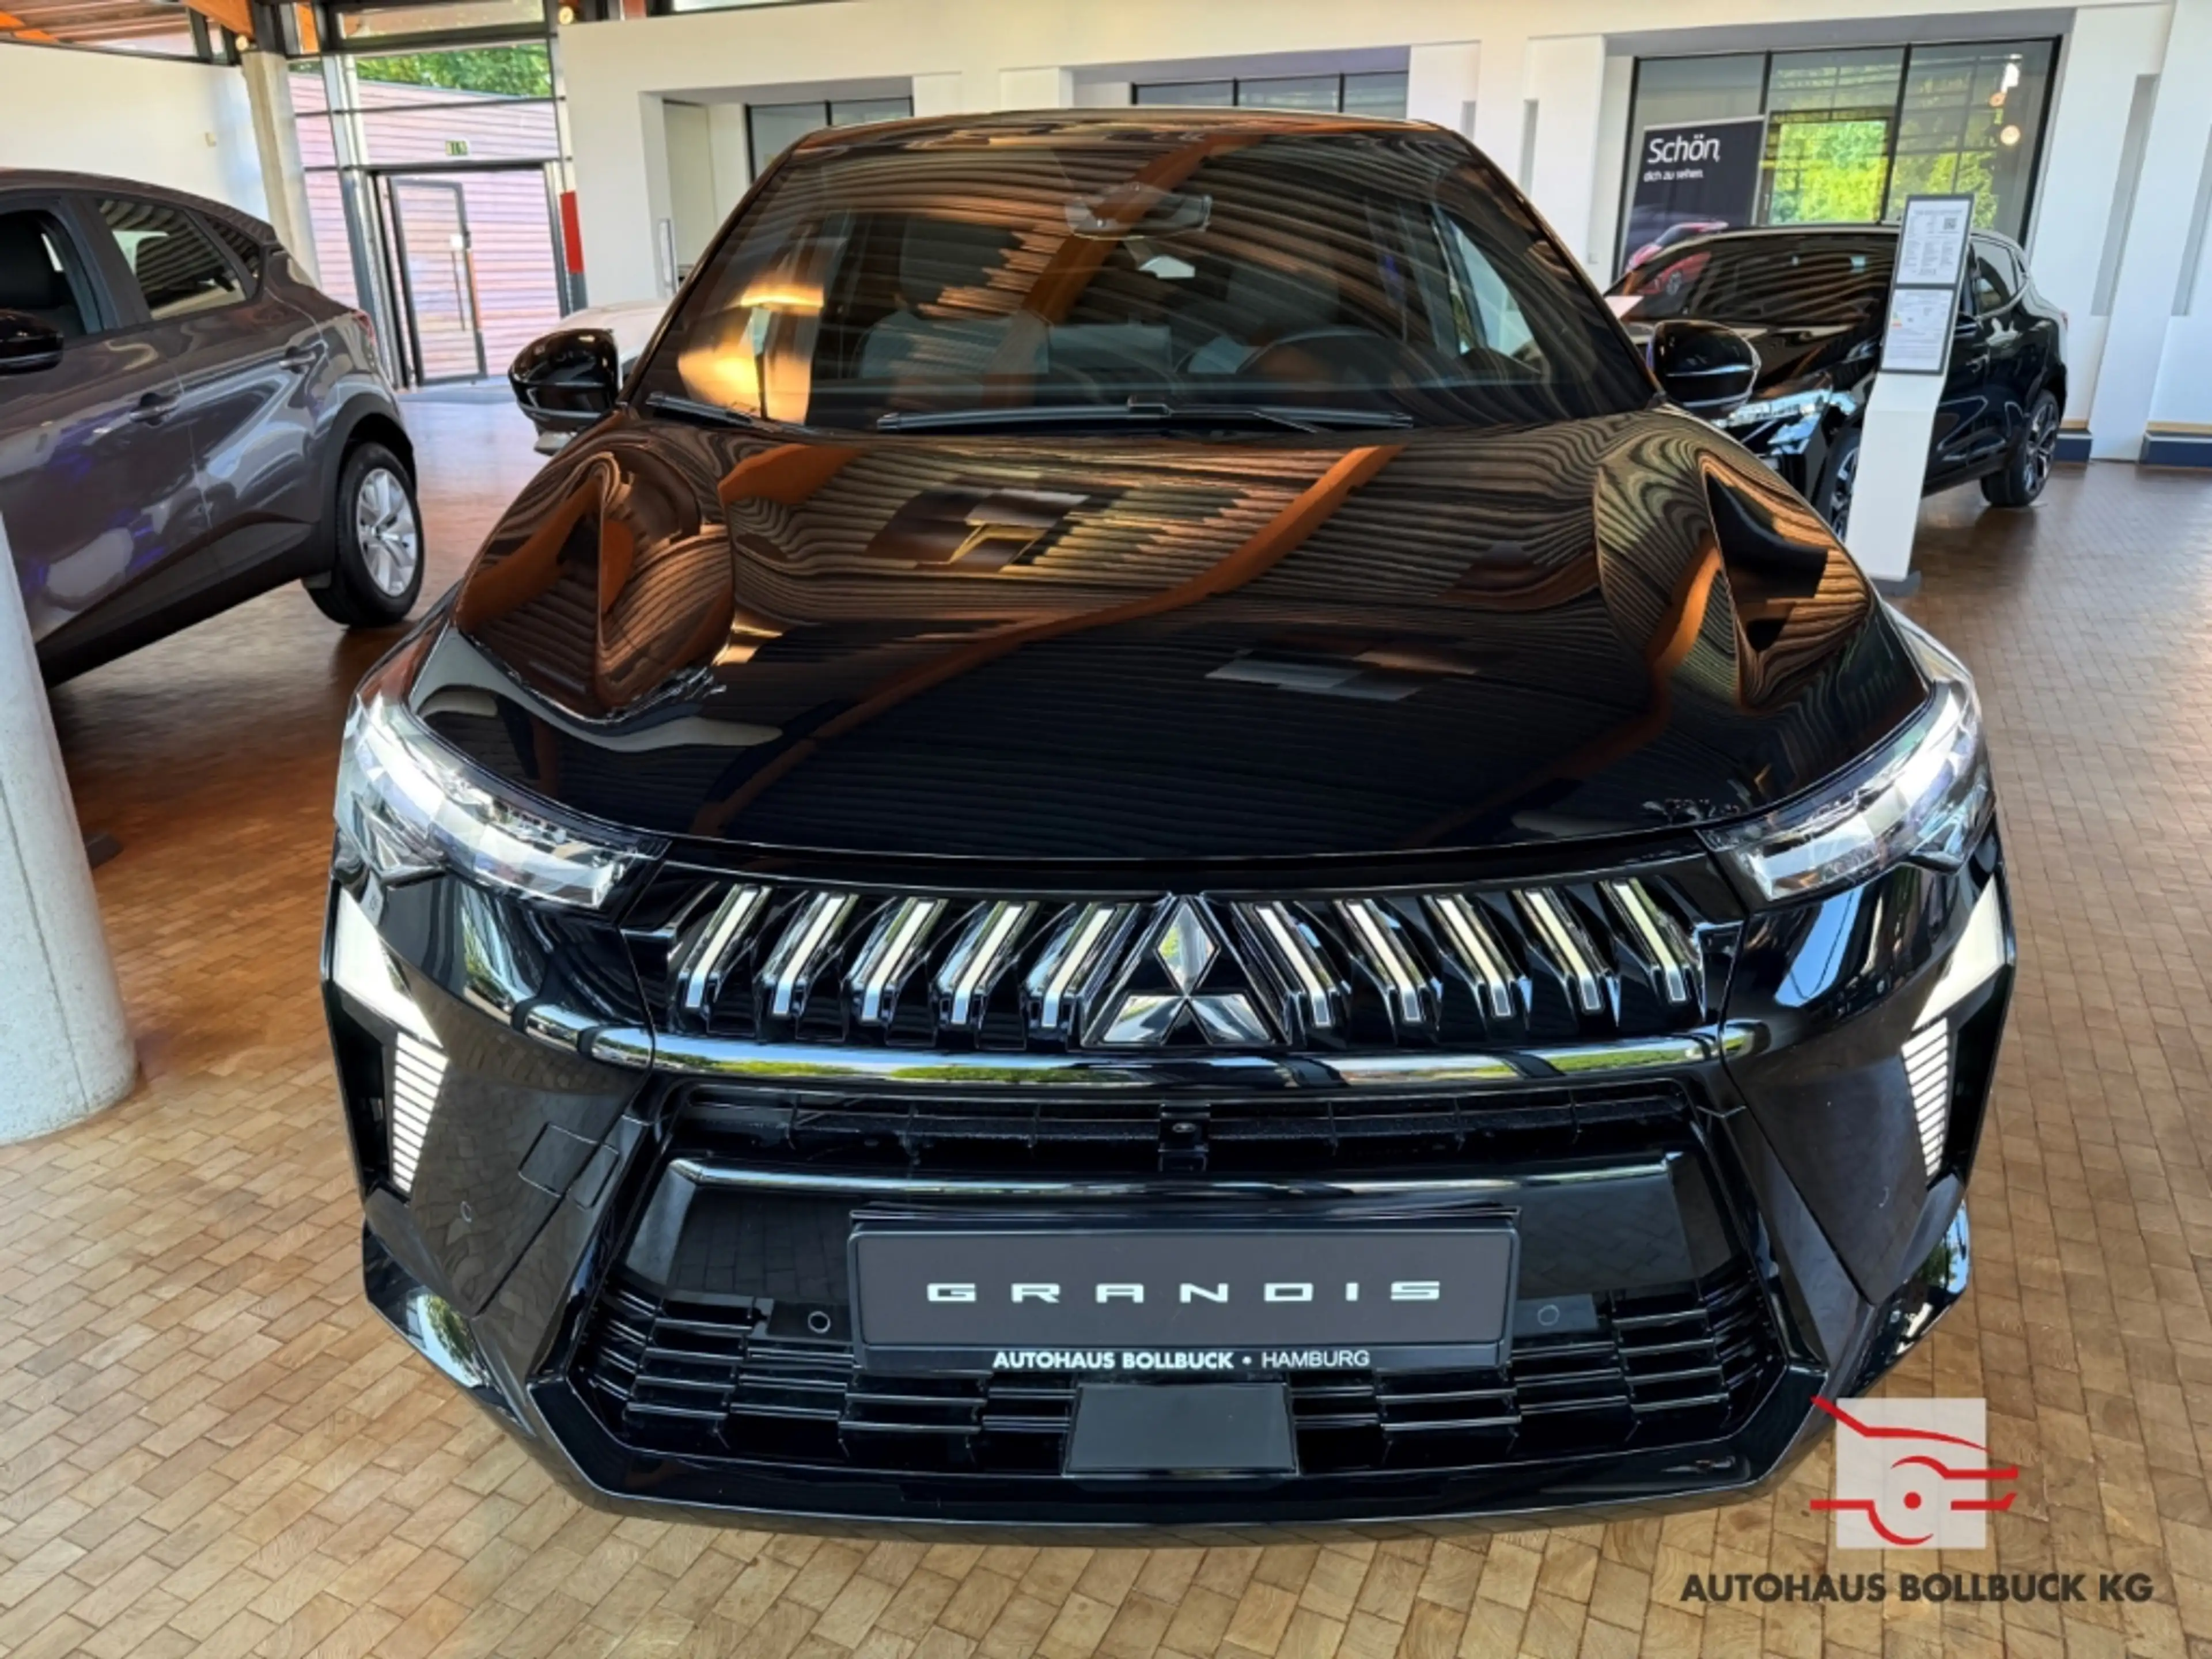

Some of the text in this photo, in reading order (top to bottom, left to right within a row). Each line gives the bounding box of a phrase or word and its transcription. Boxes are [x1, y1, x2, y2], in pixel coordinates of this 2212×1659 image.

[926, 1281, 1440, 1304] GRANDIS
[992, 1350, 1371, 1370] AUTOHAUS BOLLBUCK HAMBURG
